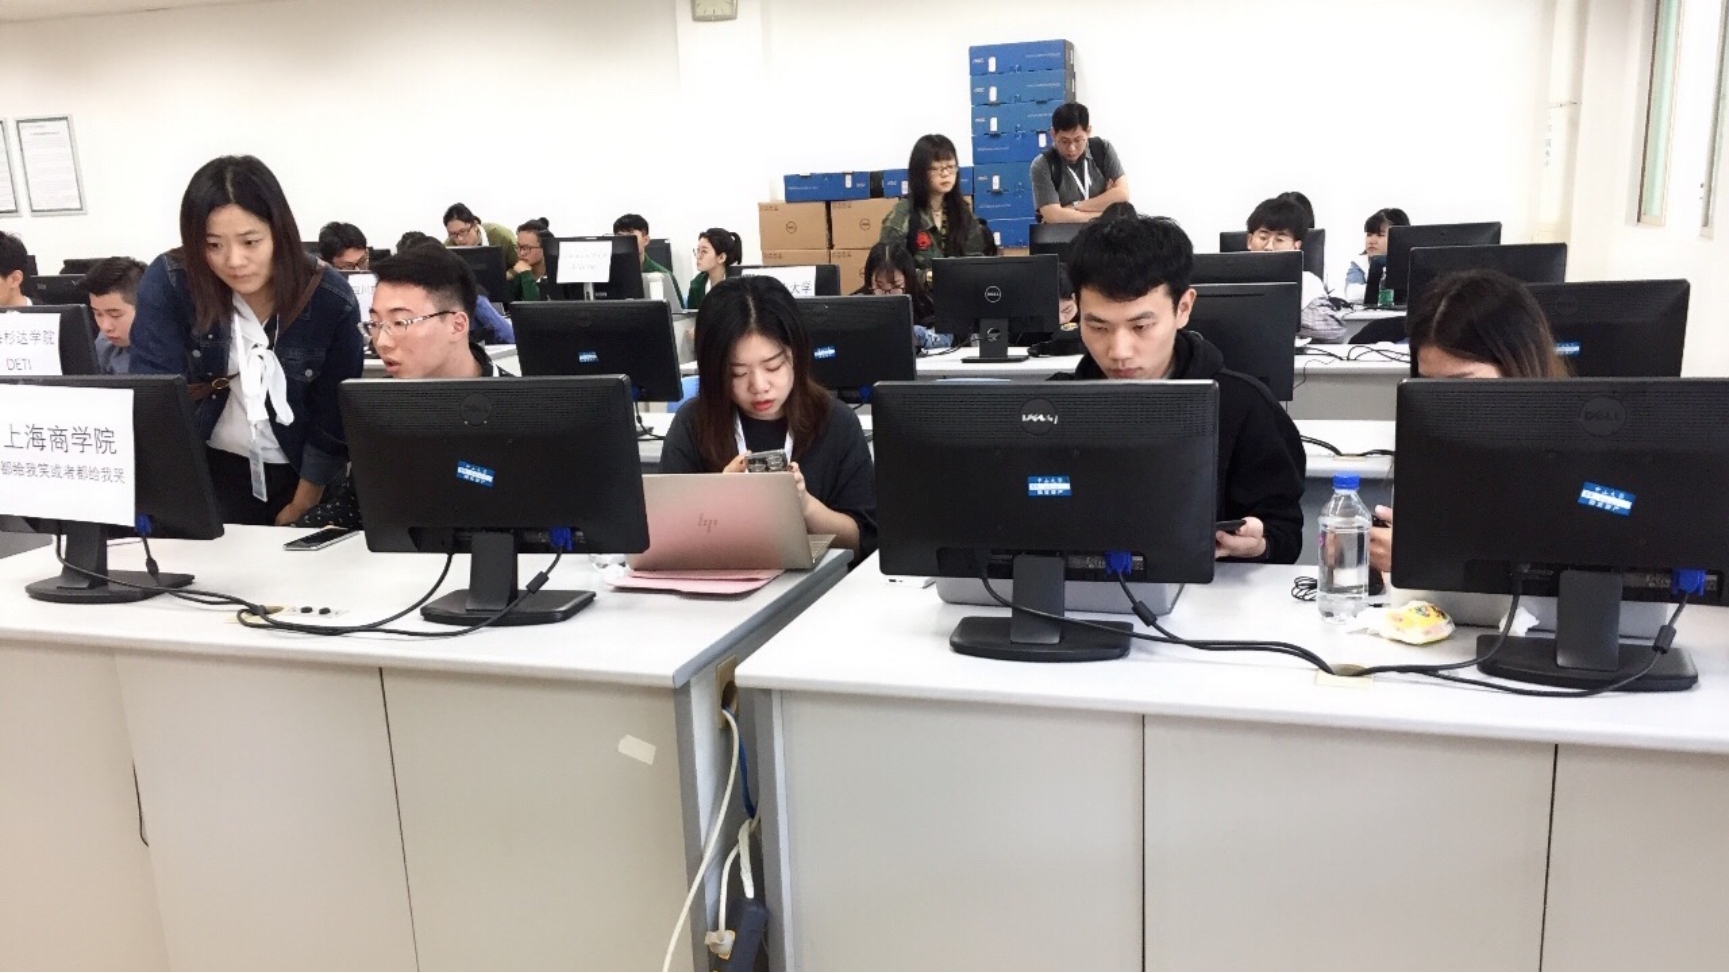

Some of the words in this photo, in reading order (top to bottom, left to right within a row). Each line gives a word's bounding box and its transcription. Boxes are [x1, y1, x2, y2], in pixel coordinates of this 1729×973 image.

[783, 281, 812, 294] 大学
[3, 423, 118, 455] 上海商学院
